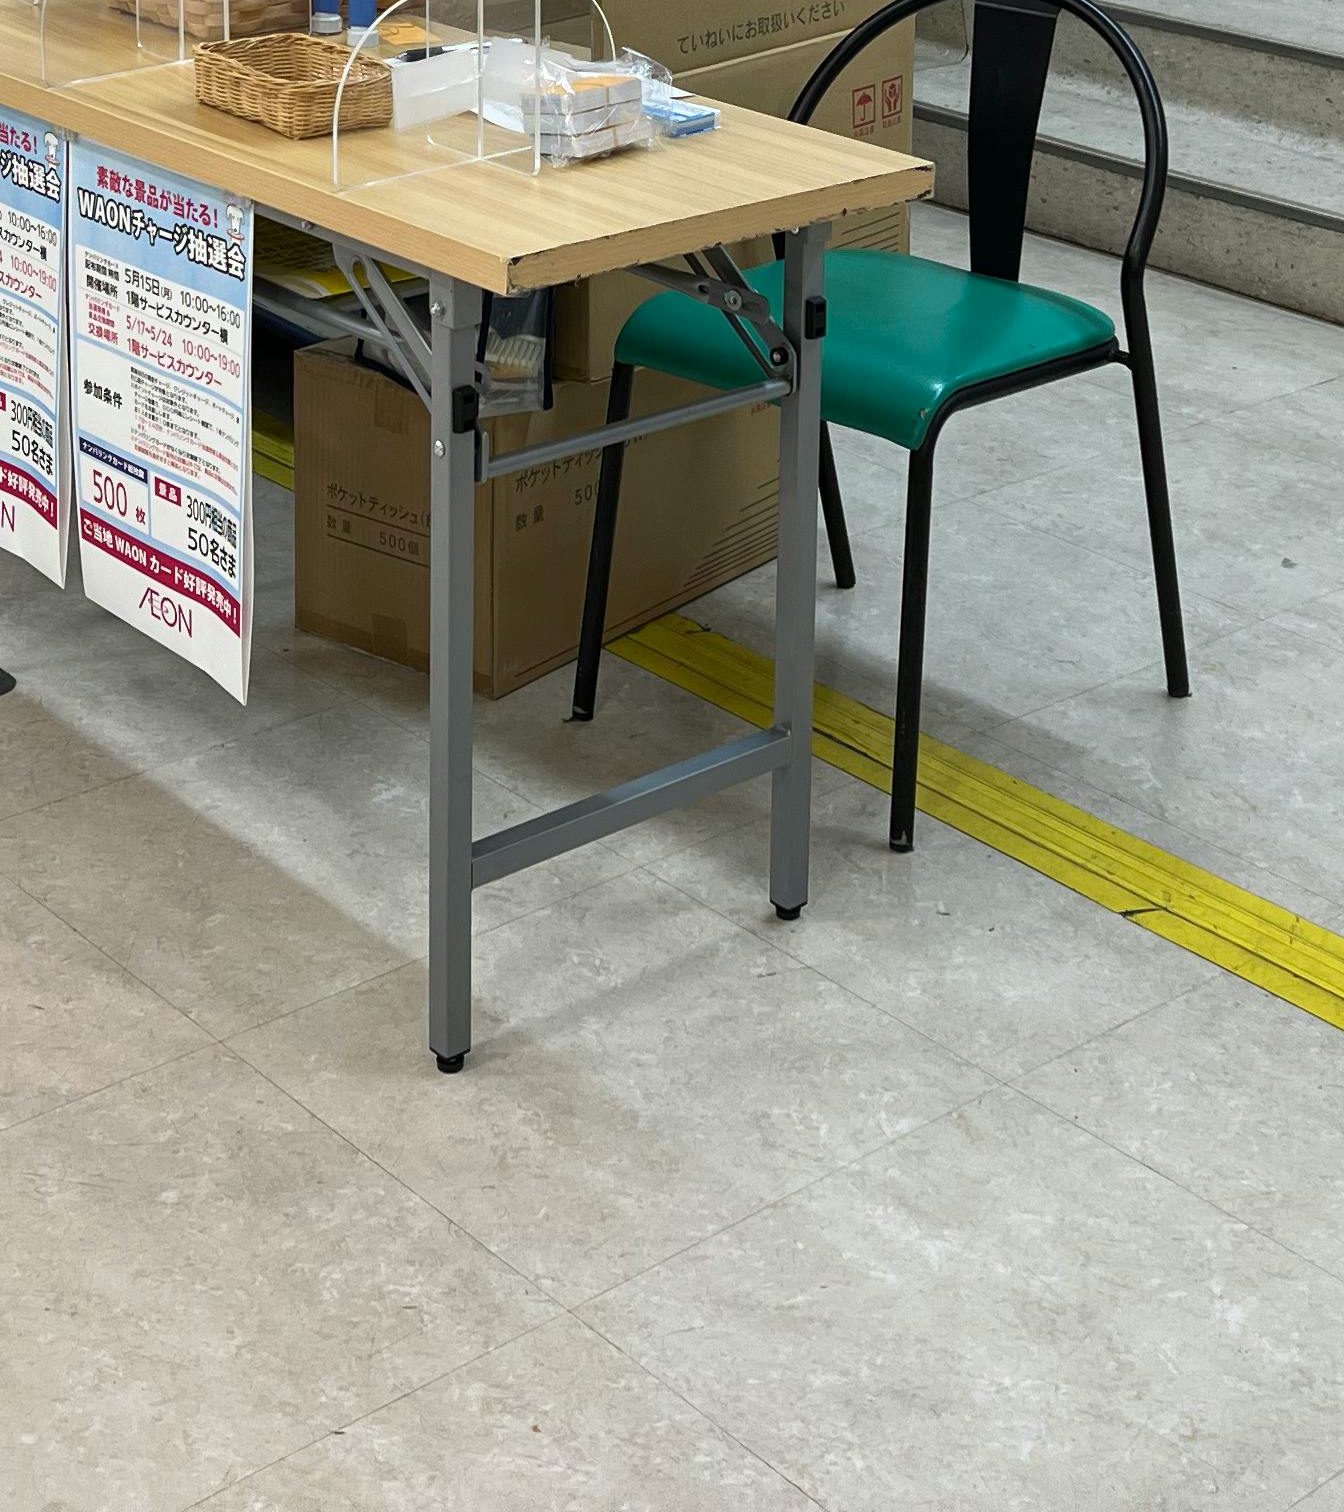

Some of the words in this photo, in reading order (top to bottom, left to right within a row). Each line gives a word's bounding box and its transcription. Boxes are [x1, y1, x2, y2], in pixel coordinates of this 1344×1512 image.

[677, 0, 846, 55] ていねいにお取扱いください
[83, 378, 123, 410] 参加条件
[11, 430, 54, 476] 50名さま
[92, 469, 128, 517] 500
[114, 535, 148, 565] WAON
[187, 527, 237, 579] 50名さま
